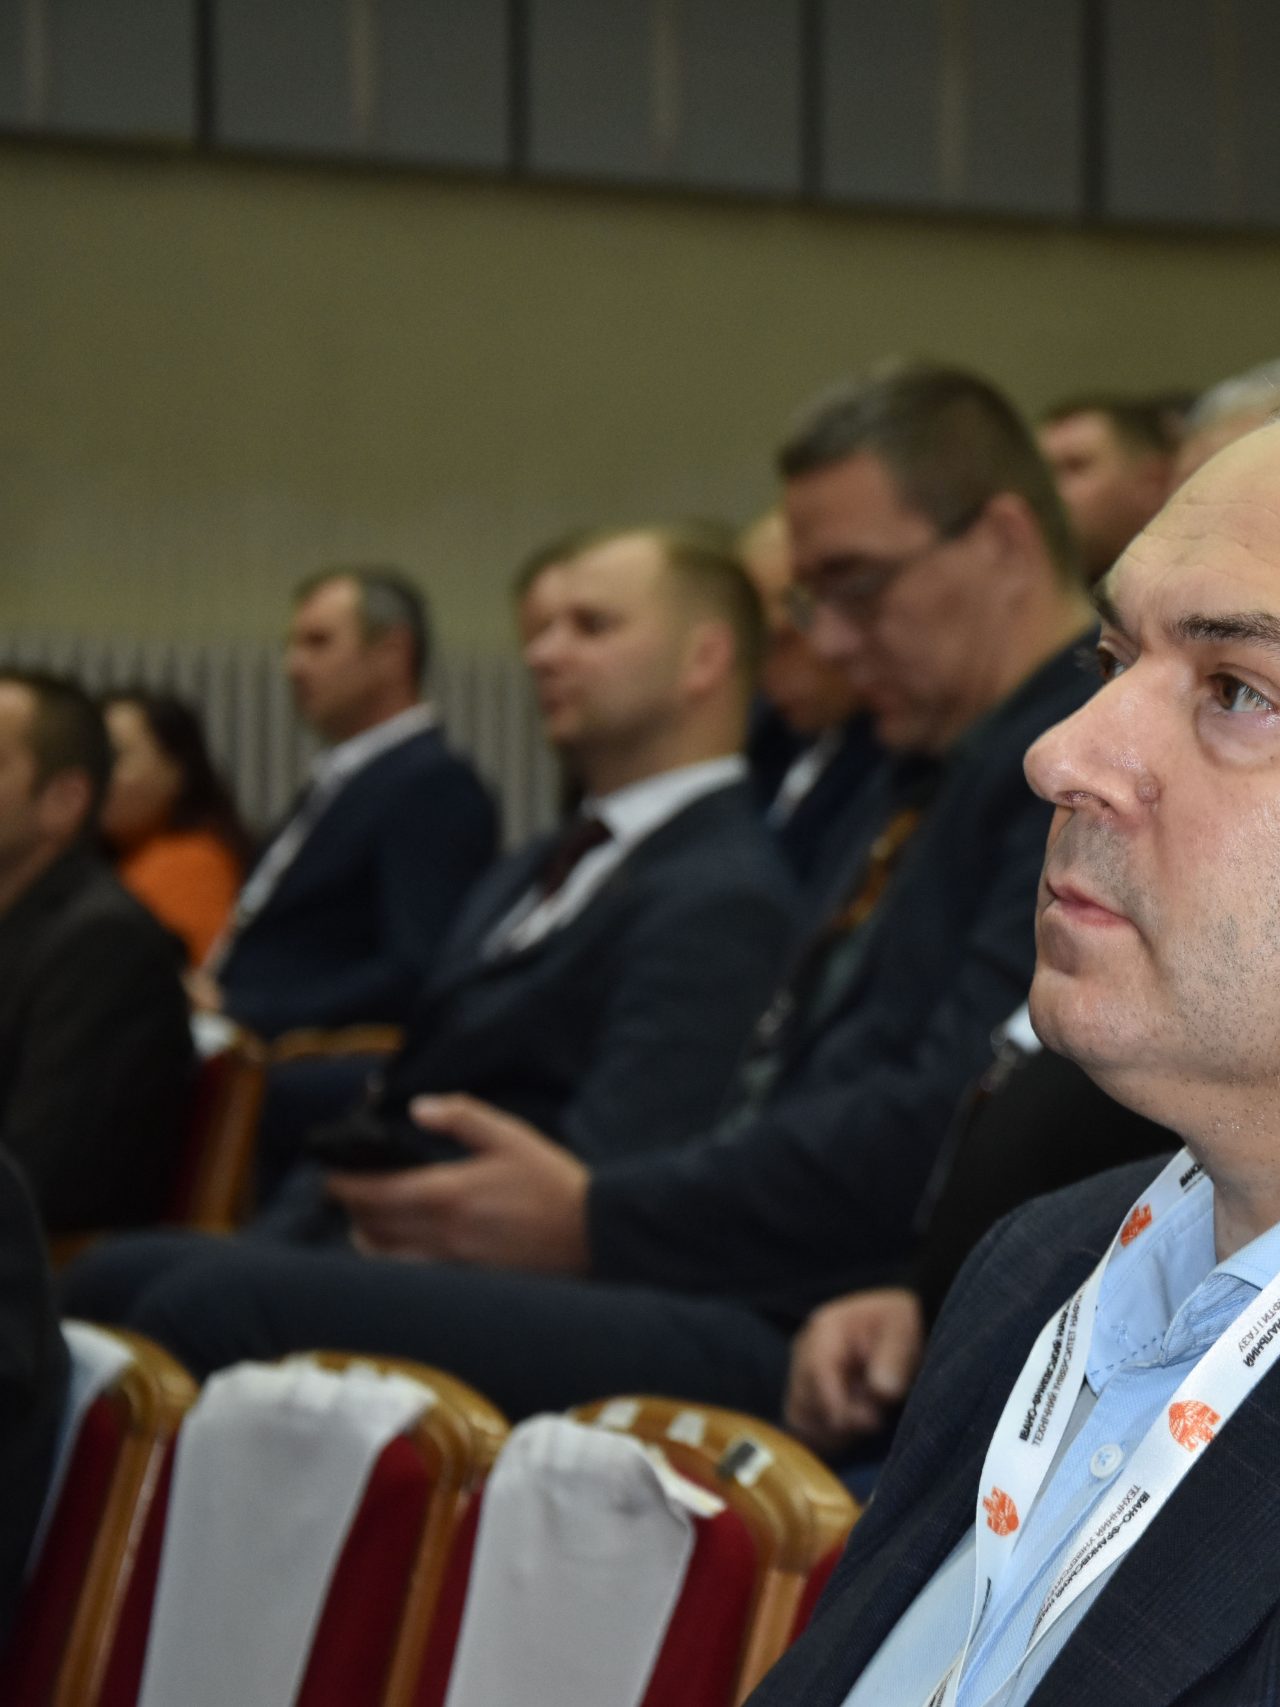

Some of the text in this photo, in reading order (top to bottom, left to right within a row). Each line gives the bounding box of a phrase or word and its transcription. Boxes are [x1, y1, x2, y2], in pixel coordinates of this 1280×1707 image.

[1238, 1325, 1260, 1352] ГАЗУ
[1031, 1389, 1058, 1447] ТЕХНІЧНИЙ
[1093, 1483, 1141, 1539] ТЕХНІЧНИЙ
[1053, 1490, 1151, 1599] ІВАНО-ФРАНКІВСЬКИЙ
